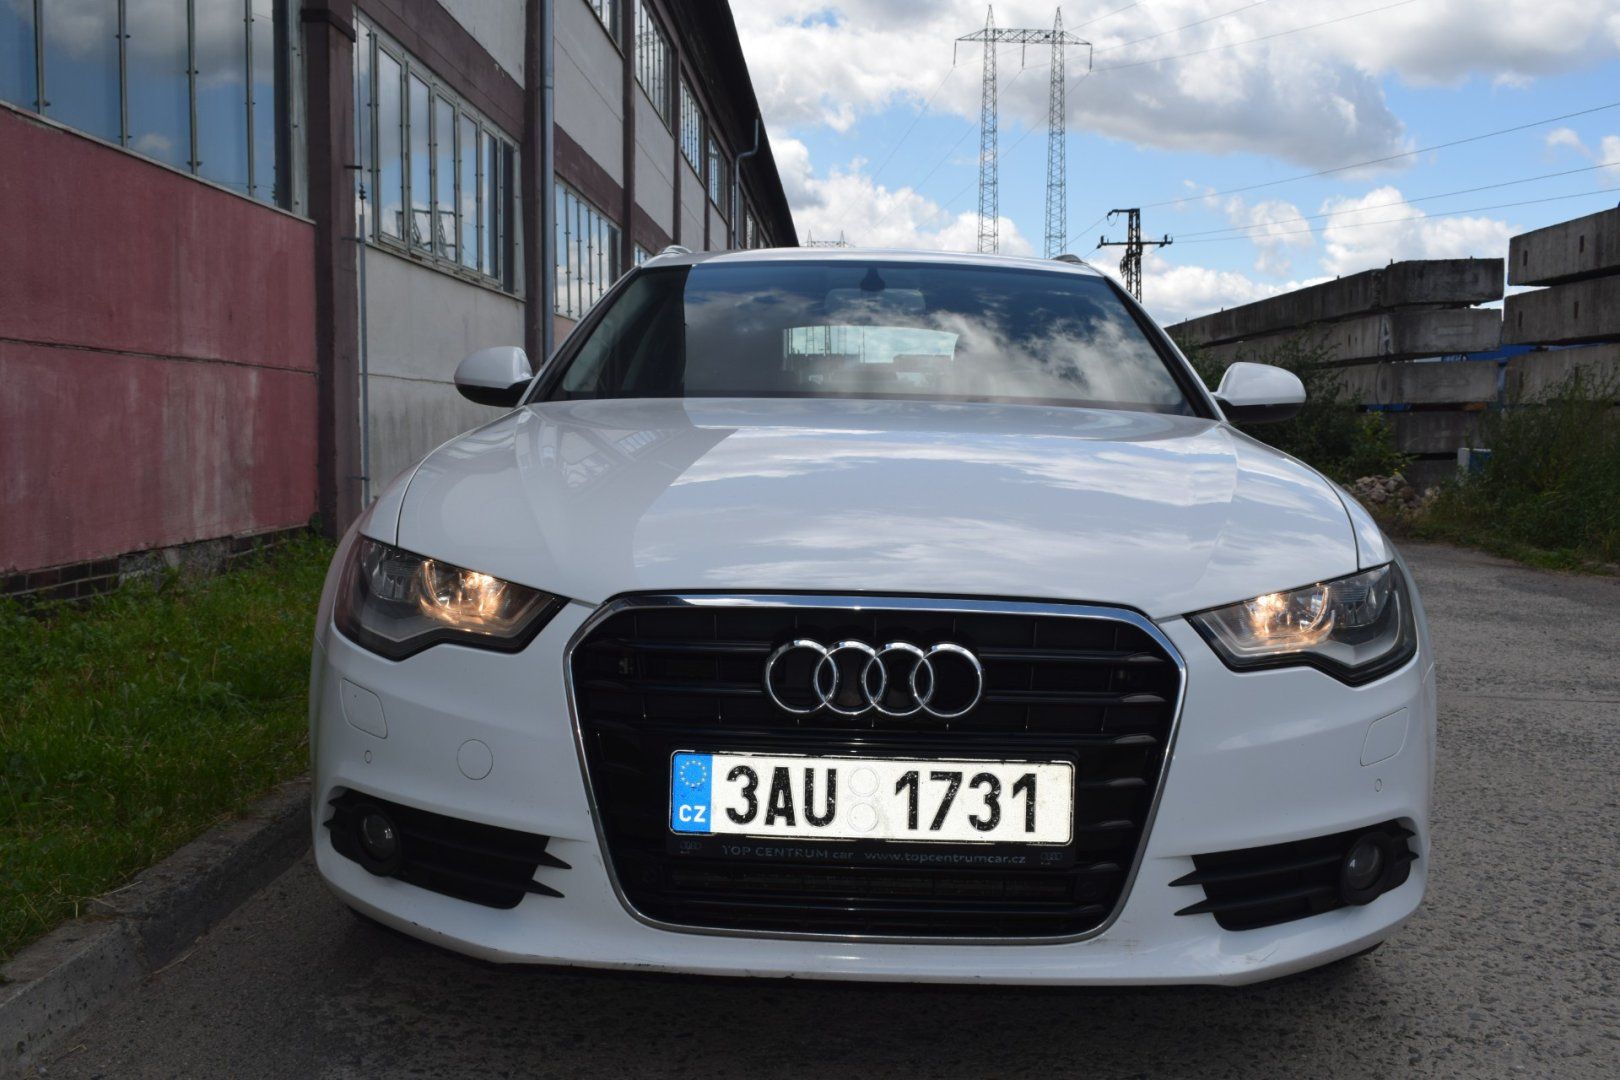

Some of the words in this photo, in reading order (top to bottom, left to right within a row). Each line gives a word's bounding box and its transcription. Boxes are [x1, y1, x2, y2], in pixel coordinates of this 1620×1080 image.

[726, 765, 838, 827] 3AU
[894, 770, 1037, 833] 1731
[679, 804, 706, 823] CZ
[722, 845, 751, 856] TOP
[754, 847, 829, 859] CENTRUM
[833, 852, 855, 860] car
[864, 851, 1026, 865] www.topcentrumcar.cz
